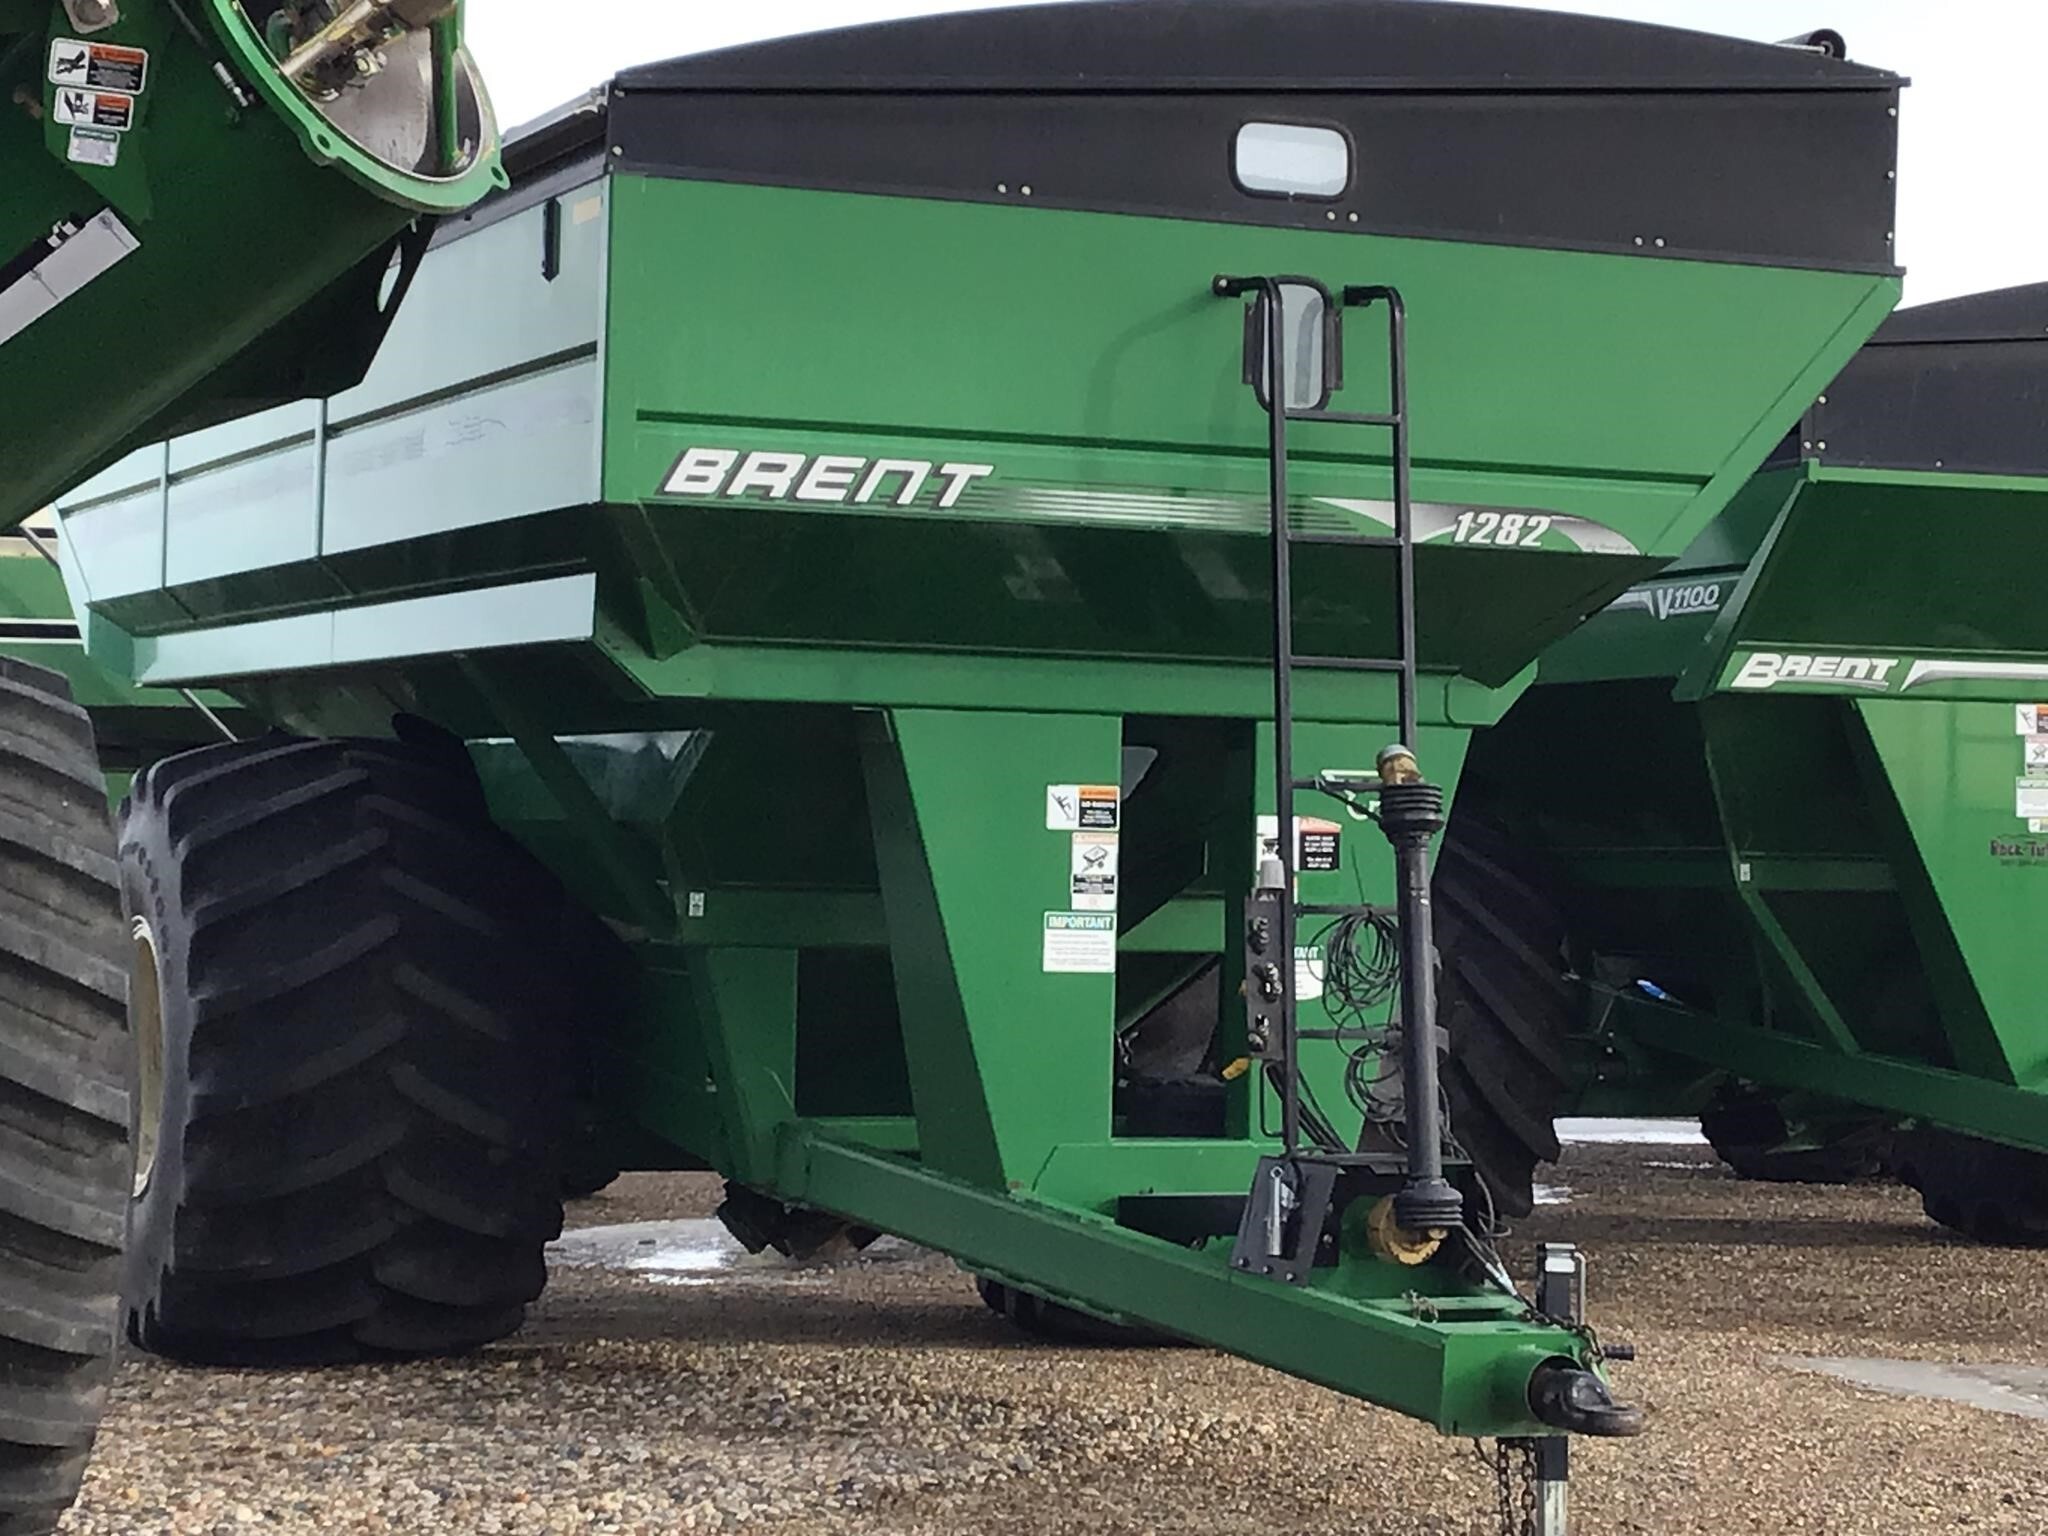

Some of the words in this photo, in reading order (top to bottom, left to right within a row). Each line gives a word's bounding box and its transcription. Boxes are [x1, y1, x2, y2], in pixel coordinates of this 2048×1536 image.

[661, 447, 995, 509] BRENT
[1452, 510, 1553, 548] 1282
[1656, 584, 1720, 620] V1100
[1730, 652, 1899, 688] BRENT
[1048, 915, 1112, 930] IMPORTANT
